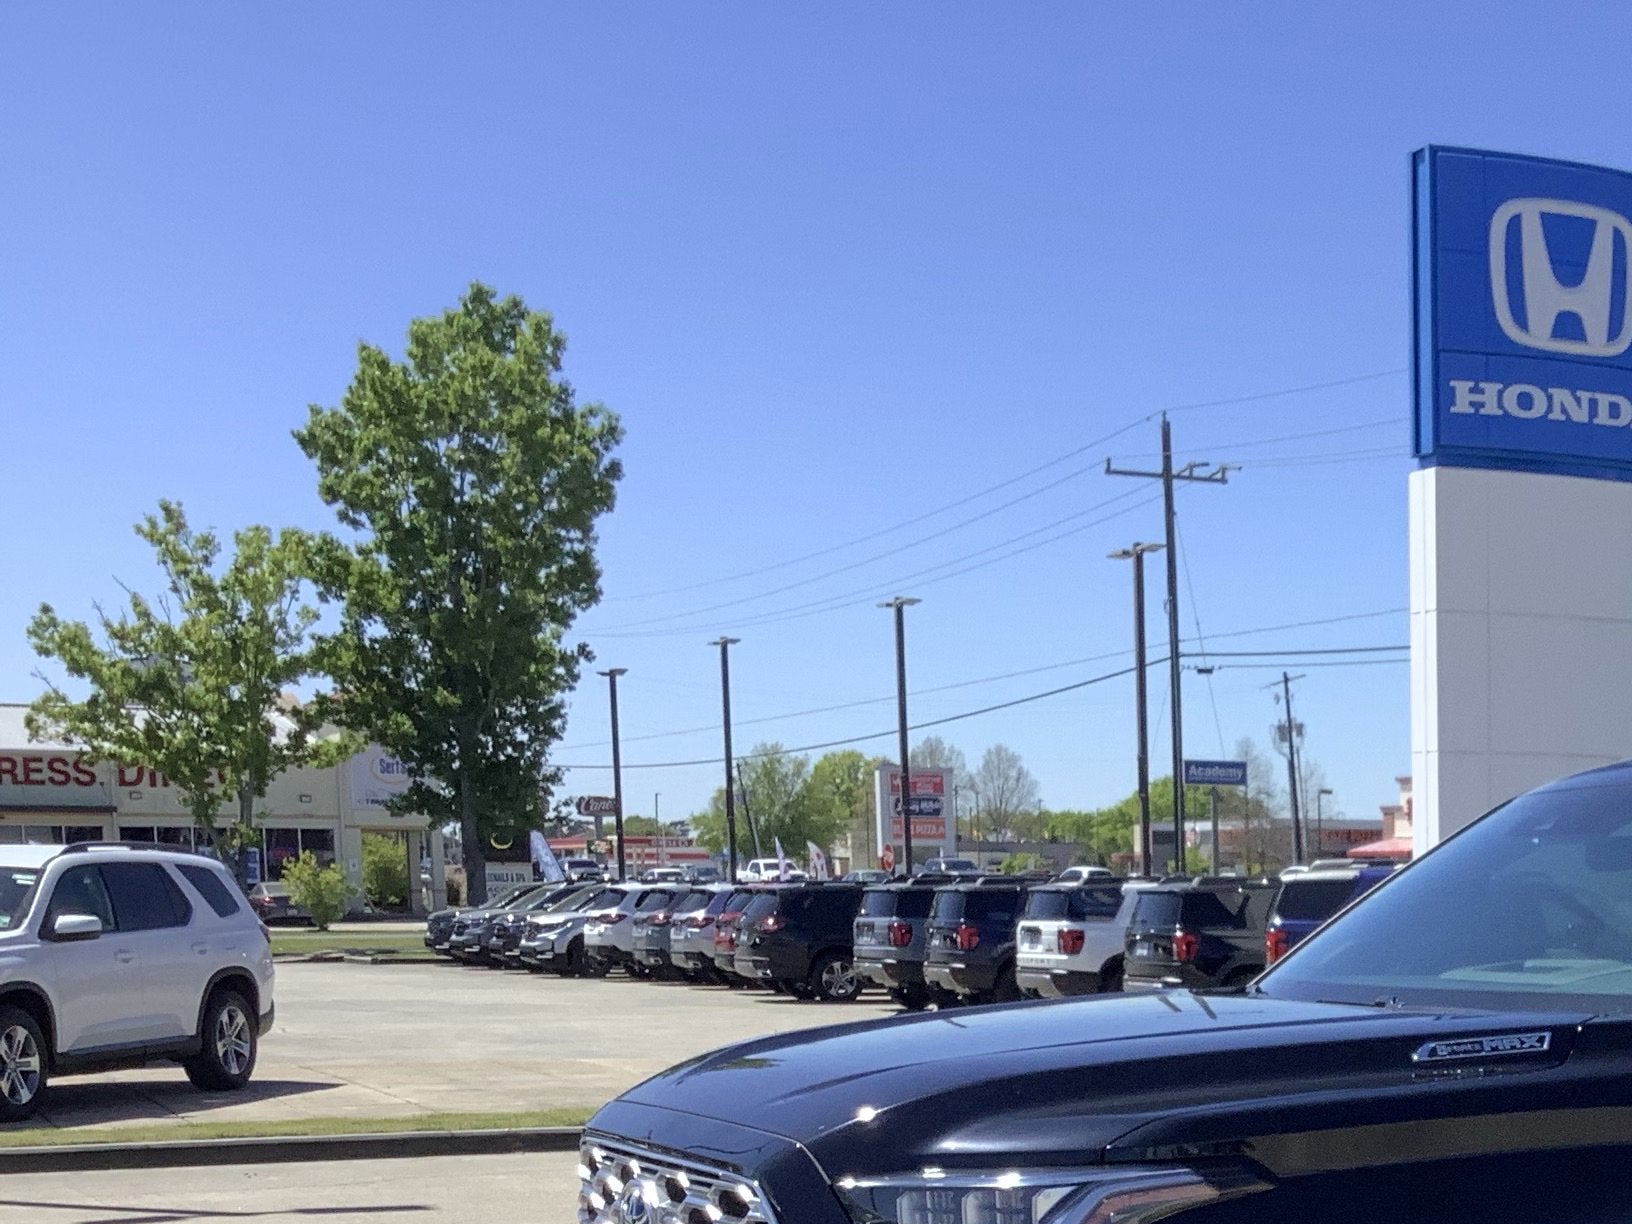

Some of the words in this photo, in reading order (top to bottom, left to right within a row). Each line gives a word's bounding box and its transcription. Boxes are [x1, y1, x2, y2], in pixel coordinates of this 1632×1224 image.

[0, 757, 96, 787] RESS
[1188, 764, 1243, 780] Academy
[580, 798, 616, 815] Cane
[1482, 1036, 1541, 1051] MAX
